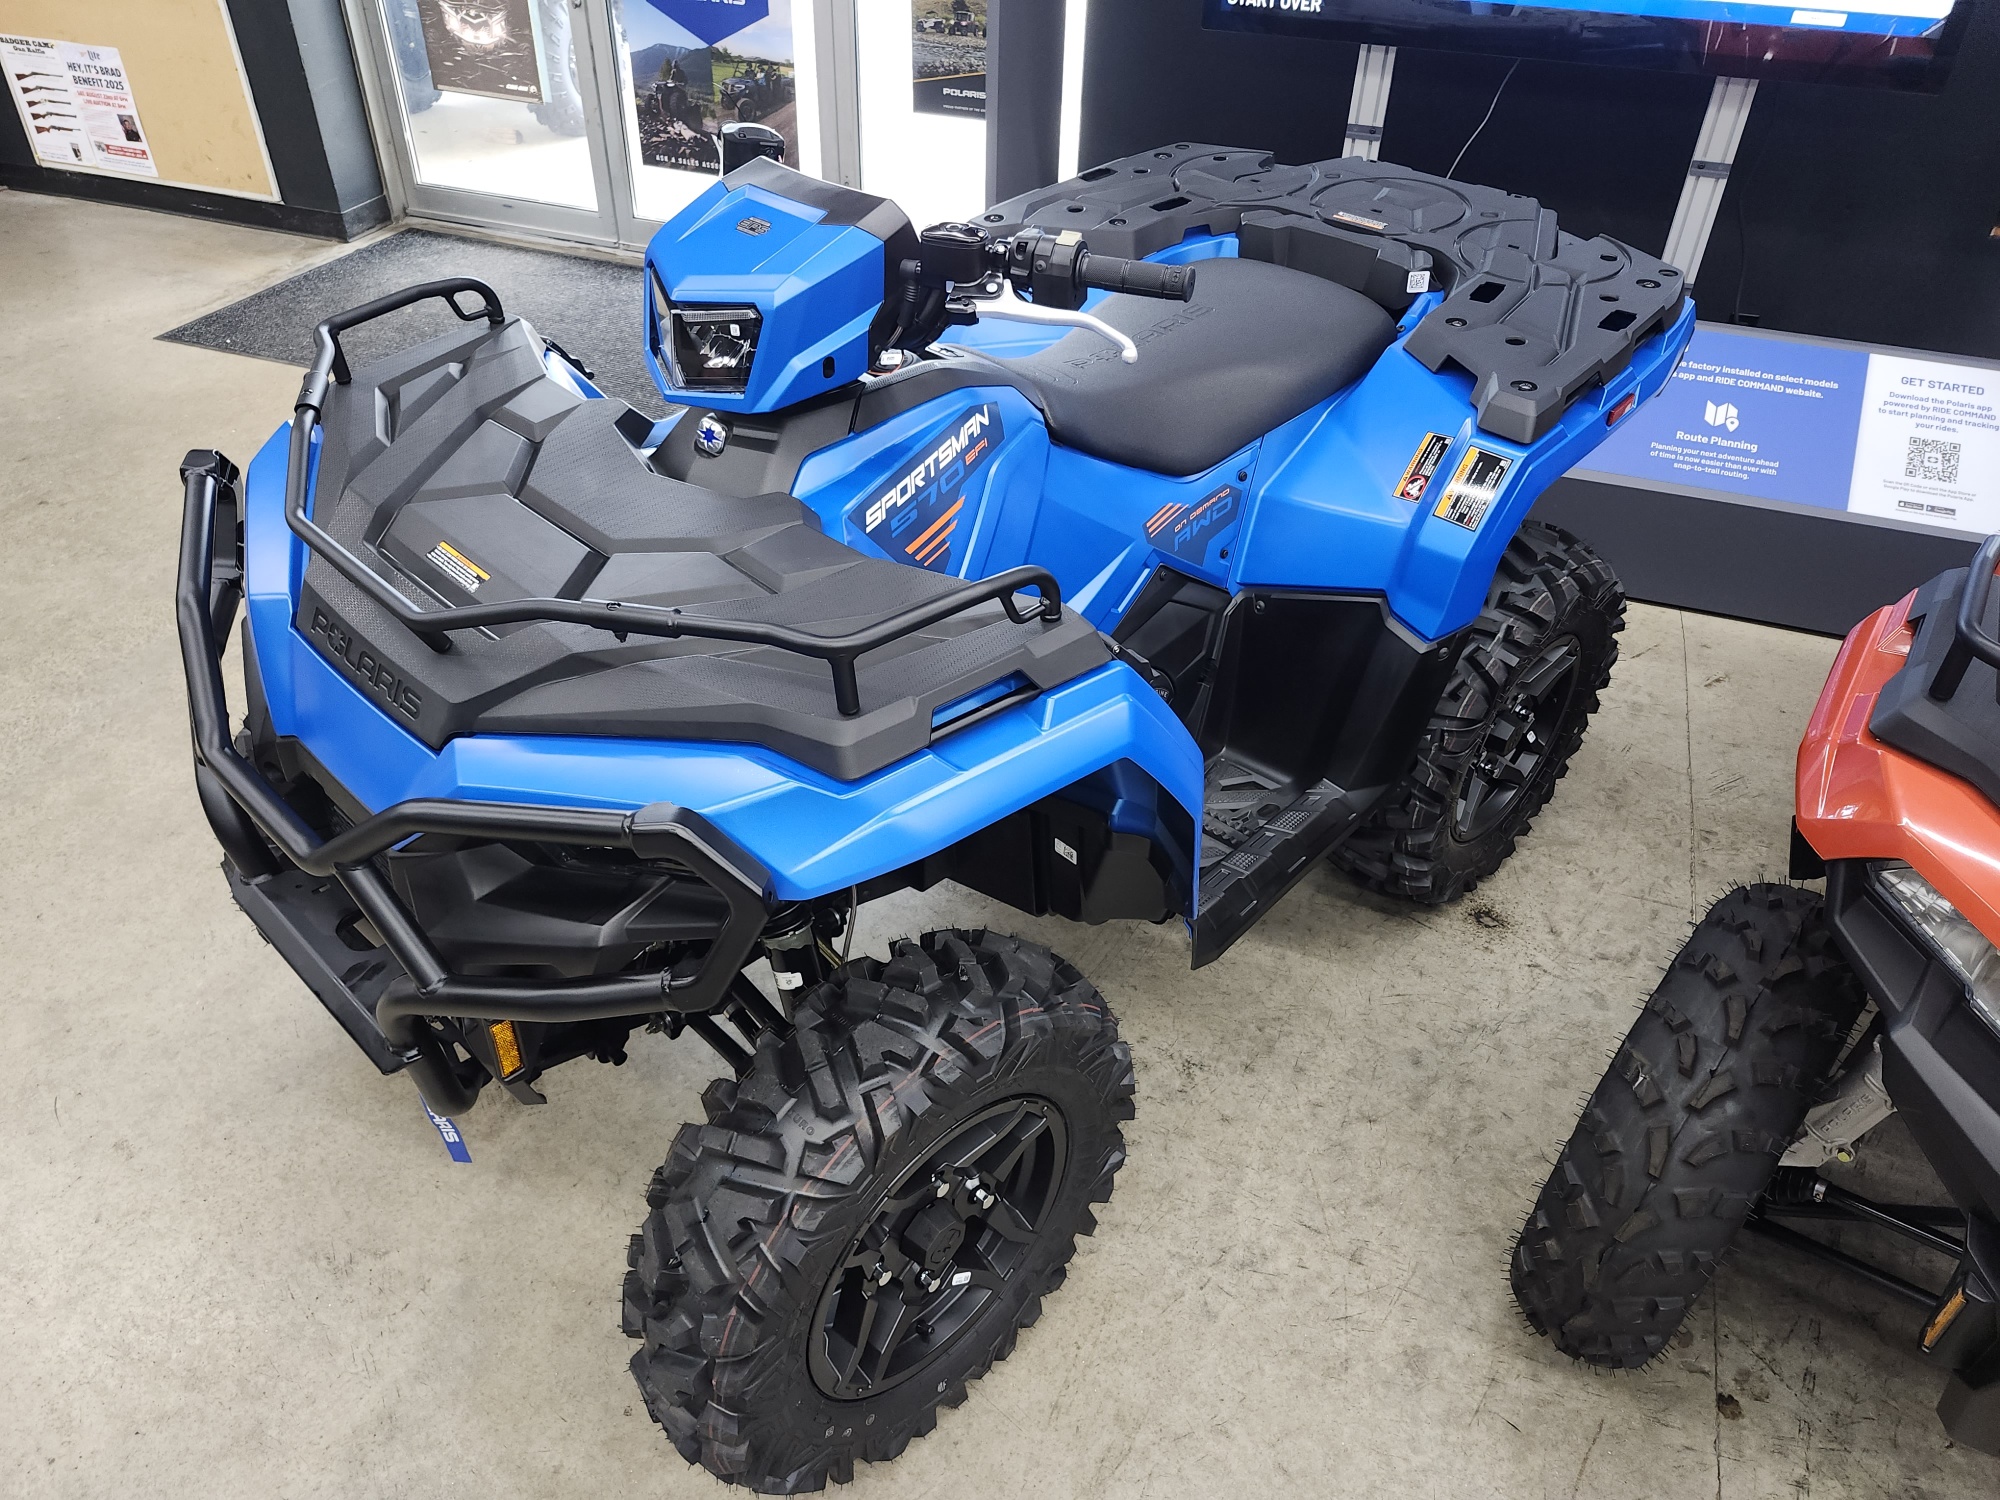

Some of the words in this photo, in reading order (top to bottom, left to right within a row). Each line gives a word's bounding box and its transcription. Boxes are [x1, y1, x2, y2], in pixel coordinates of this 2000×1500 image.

[1280, 0, 1321, 12] OVER
[66, 62, 84, 73] HEY,
[84, 64, 99, 74] IT'S
[99, 66, 121, 77] BRAD
[72, 75, 103, 88] BENEFIT
[104, 80, 124, 90] 2025
[943, 88, 986, 99] POLARIS
[678, 158, 699, 166] SALES
[702, 161, 720, 170] ASSO
[1062, 304, 1216, 370] POARIS
[1678, 372, 1695, 381] app
[1715, 376, 1736, 385] RIDE
[1737, 379, 1784, 392] COMMAND
[1785, 388, 1824, 398] website.
[1689, 361, 1721, 374] factory
[1722, 366, 1761, 377] installed
[1775, 375, 1804, 384] select
[1804, 379, 1838, 389] models
[1901, 376, 1925, 387] GET
[1928, 380, 1984, 396] STARTED
[1883, 400, 1919, 410] powered
[1920, 404, 1931, 413] by
[1932, 406, 1951, 414] RIDE
[1953, 409, 1996, 420] COMMAND
[1889, 391, 1929, 402] Download
[1946, 400, 1975, 410] Polaris
[1888, 409, 1909, 417] start
[1910, 412, 1945, 424] planning
[1964, 420, 2000, 432] tracking
[1935, 424, 1959, 433] rides.
[1676, 430, 1708, 444] Route
[1710, 436, 1758, 453] Planning
[1651, 442, 1682, 453] Planning
[1718, 452, 1755, 464] adventure
[1756, 459, 1779, 468] ahead
[1659, 451, 1675, 459] time
[1724, 461, 1741, 470] than
[866, 404, 989, 534] SPORTSMAN
[1673, 462, 1720, 474] snap-to-trail
[1721, 470, 1749, 480] routing.
[890, 459, 965, 538] 570
[965, 437, 988, 466] EFI
[1175, 519, 1187, 533] ON
[1190, 488, 1229, 520] DEMAND
[1175, 496, 1232, 552] AWD
[310, 606, 422, 721] POLARIS
